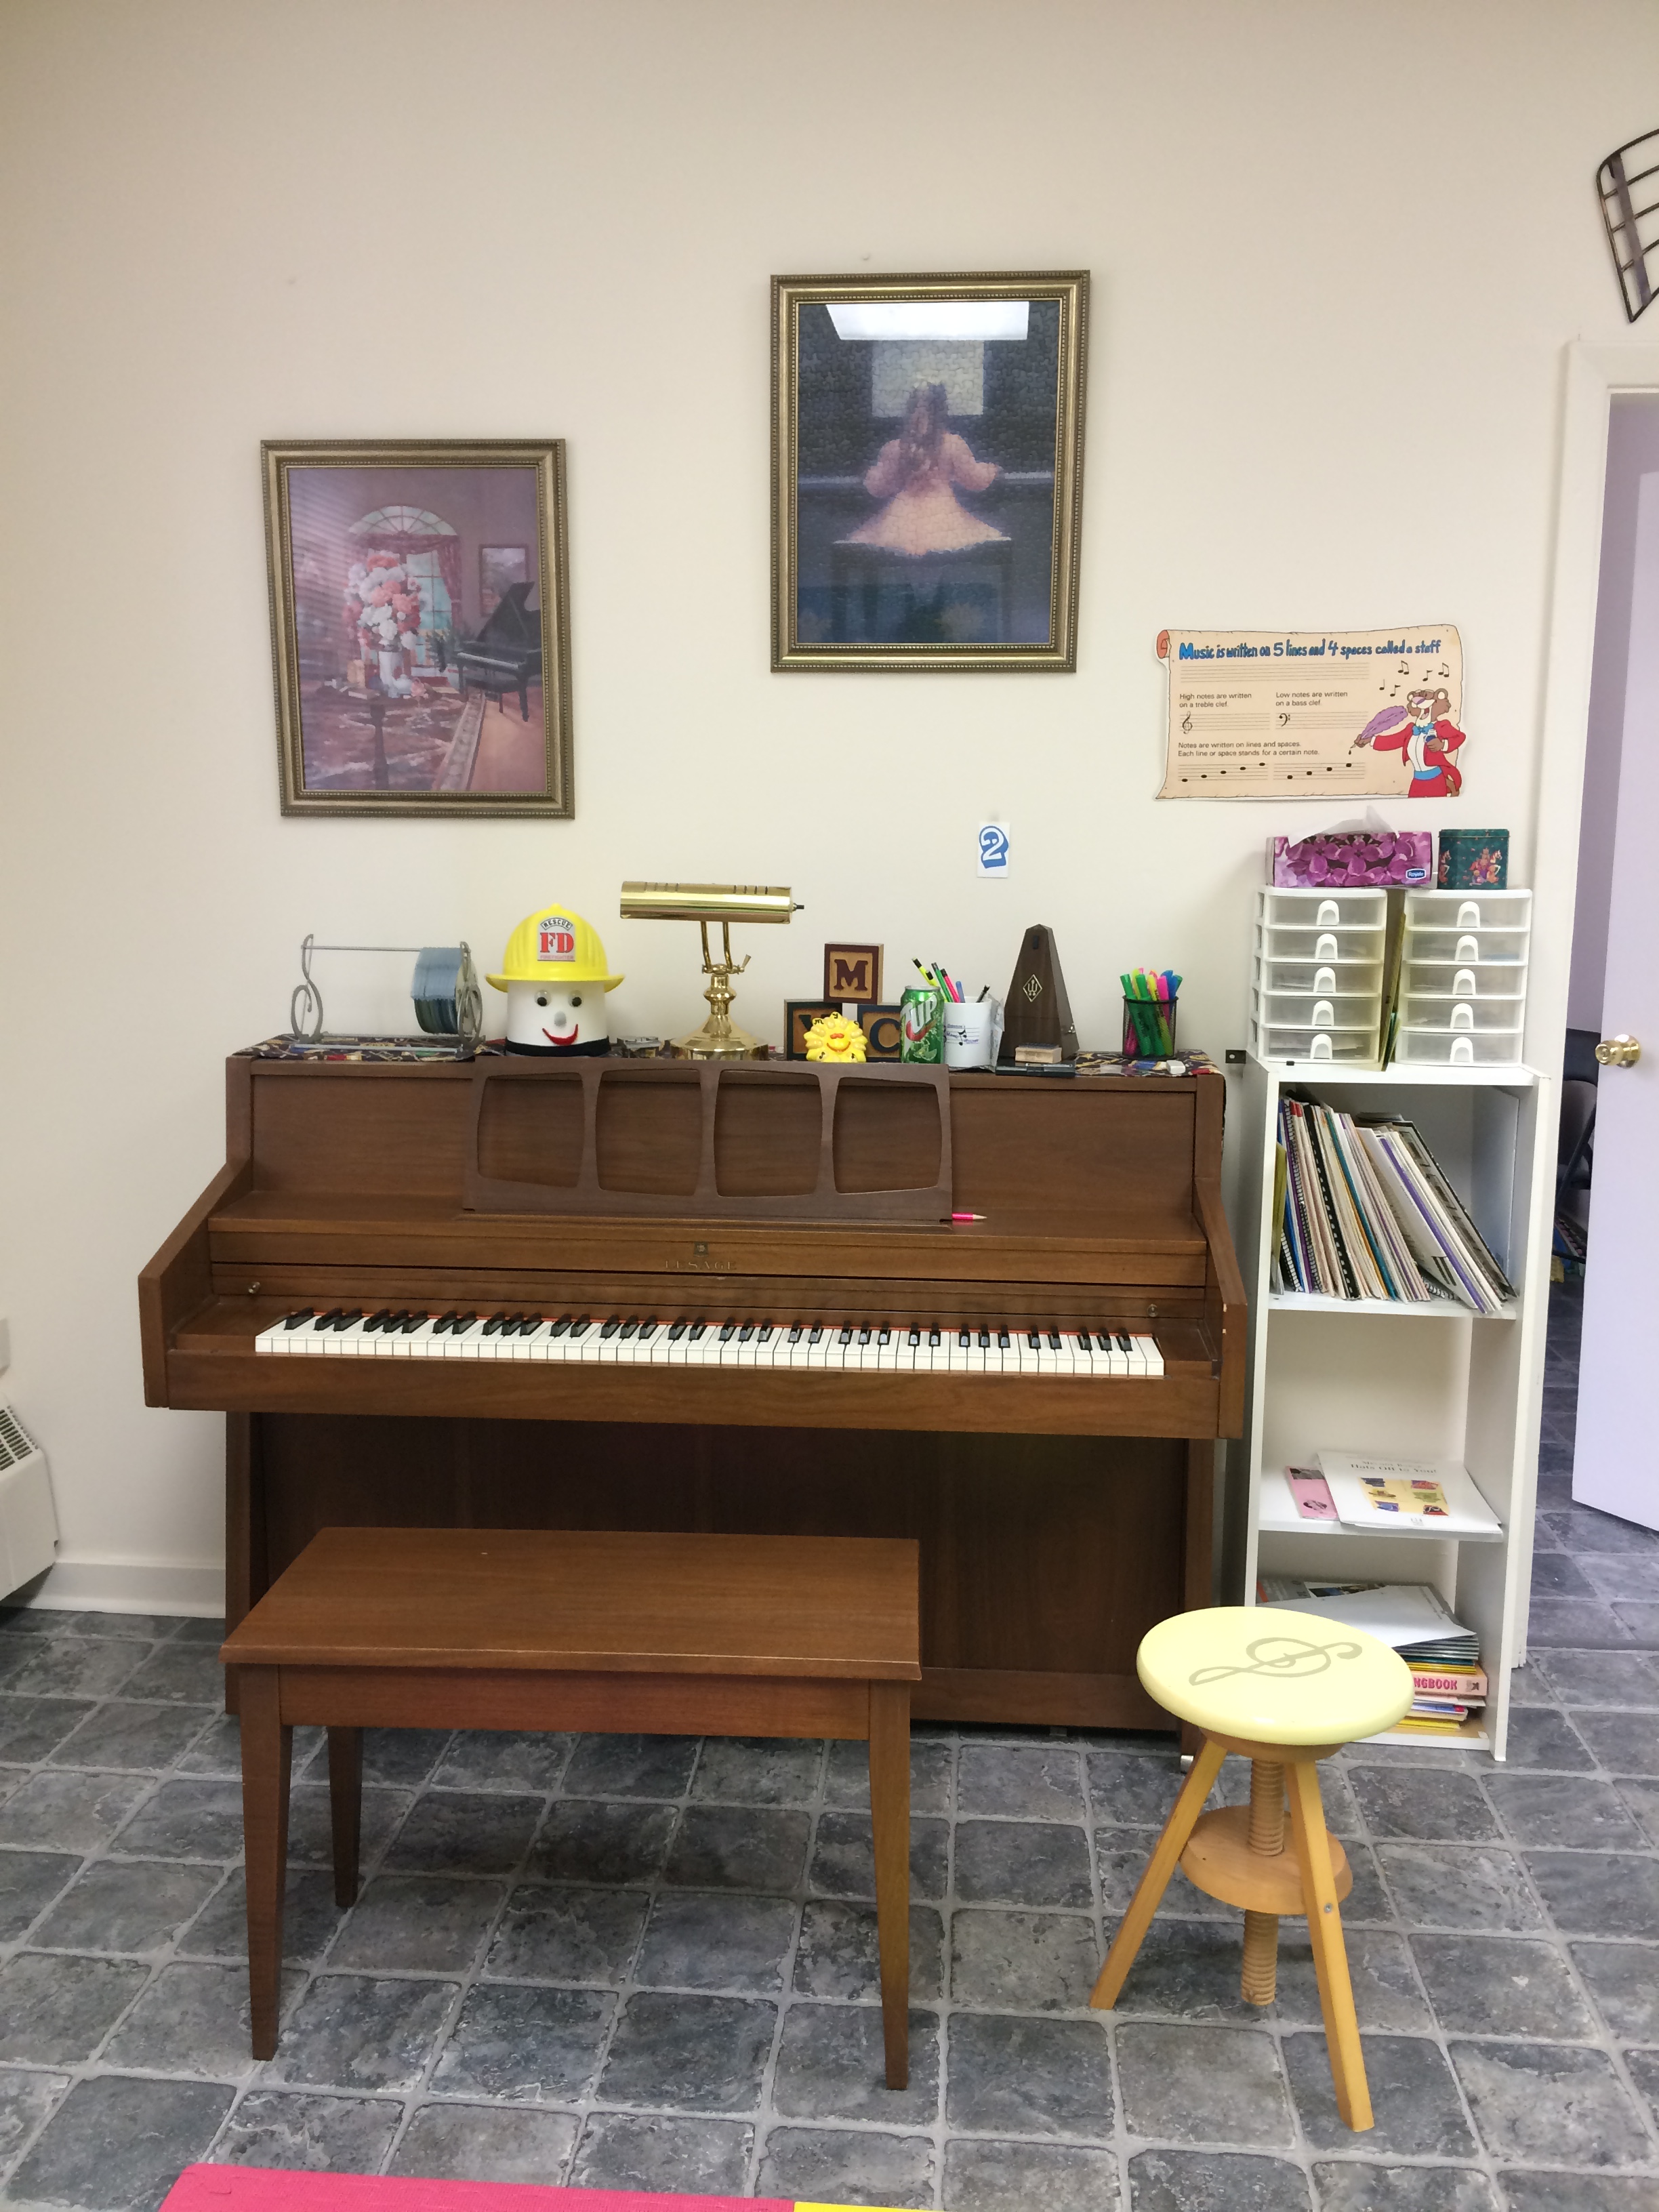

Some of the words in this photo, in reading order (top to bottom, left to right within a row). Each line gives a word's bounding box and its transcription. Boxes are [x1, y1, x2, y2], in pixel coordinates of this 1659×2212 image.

[1179, 642, 1214, 660] Music
[1216, 644, 1225, 659] is
[1226, 642, 1258, 658] written
[1259, 645, 1271, 657] on
[1273, 642, 1284, 657] 5
[1286, 638, 1307, 657] lines
[1308, 638, 1326, 656] and
[1328, 640, 1338, 656] 4
[1340, 644, 1372, 660] spaces
[1375, 639, 1406, 655] called
[1406, 646, 1413, 654] a
[1414, 639, 1441, 654] staff
[979, 825, 1009, 869] 2
[544, 919, 571, 928] RESCUE
[539, 932, 574, 953] FD
[833, 959, 868, 991] M
[869, 1018, 901, 1053] C
[900, 994, 937, 1059] 7UP
[1414, 1677, 1458, 1690] NGBOOK
